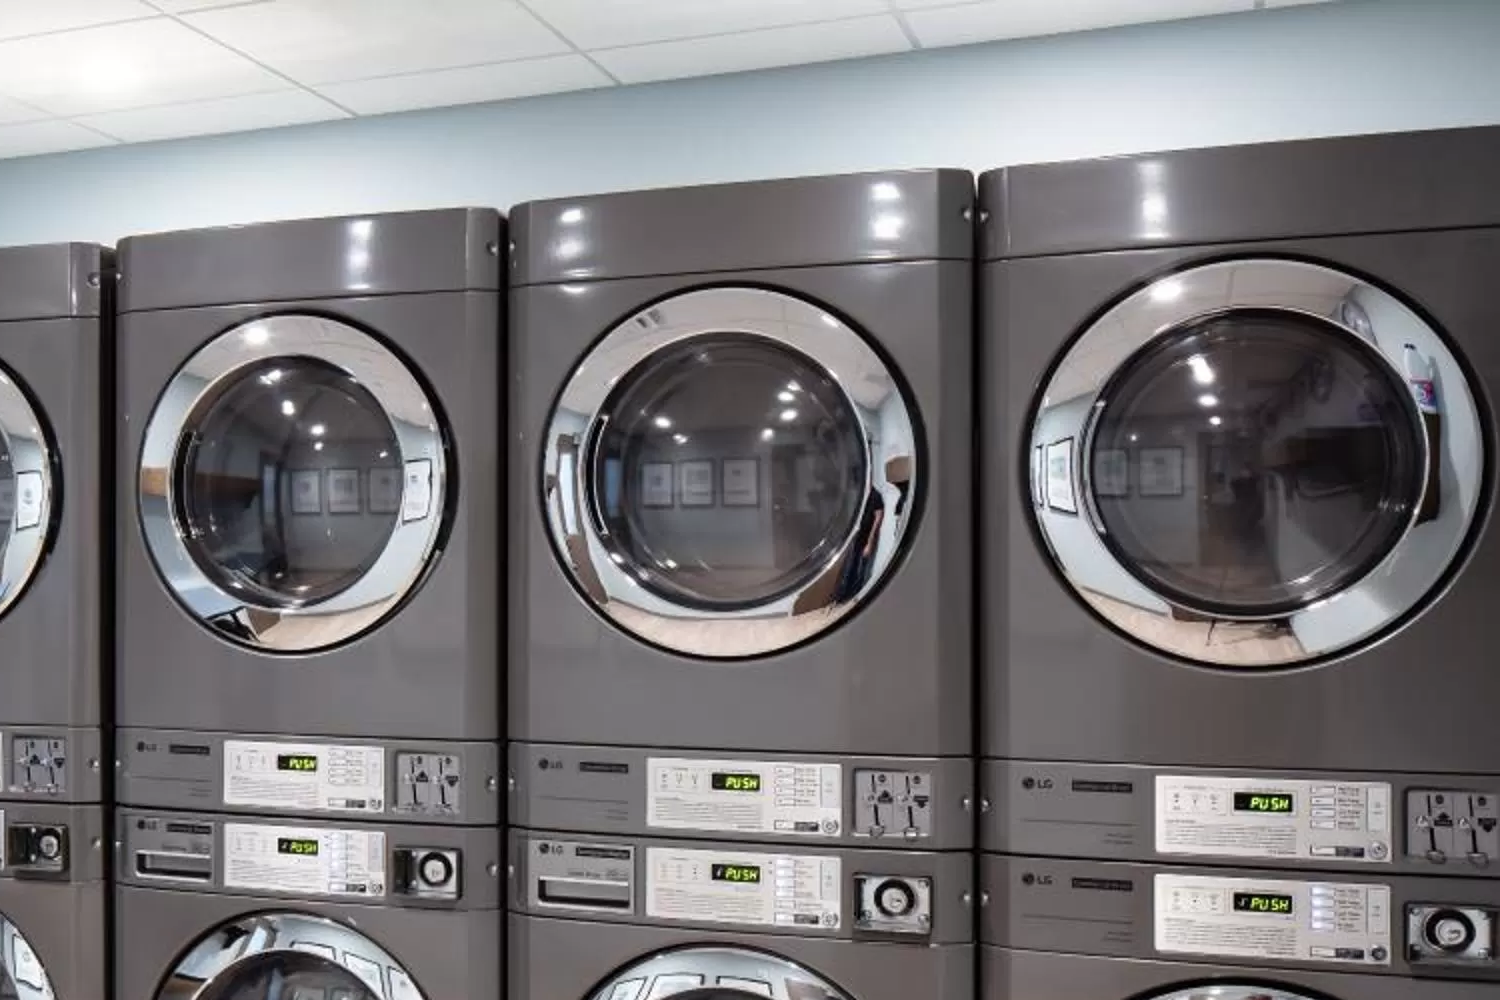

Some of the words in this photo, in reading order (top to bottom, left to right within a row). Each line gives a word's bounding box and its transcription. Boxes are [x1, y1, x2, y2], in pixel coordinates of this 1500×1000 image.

[289, 758, 316, 770] PUSH
[725, 776, 758, 789] PUSH
[1250, 796, 1289, 811] PUSH
[290, 841, 317, 854] PUSH
[725, 866, 758, 881] PUSH
[1250, 897, 1289, 911] PUSH
